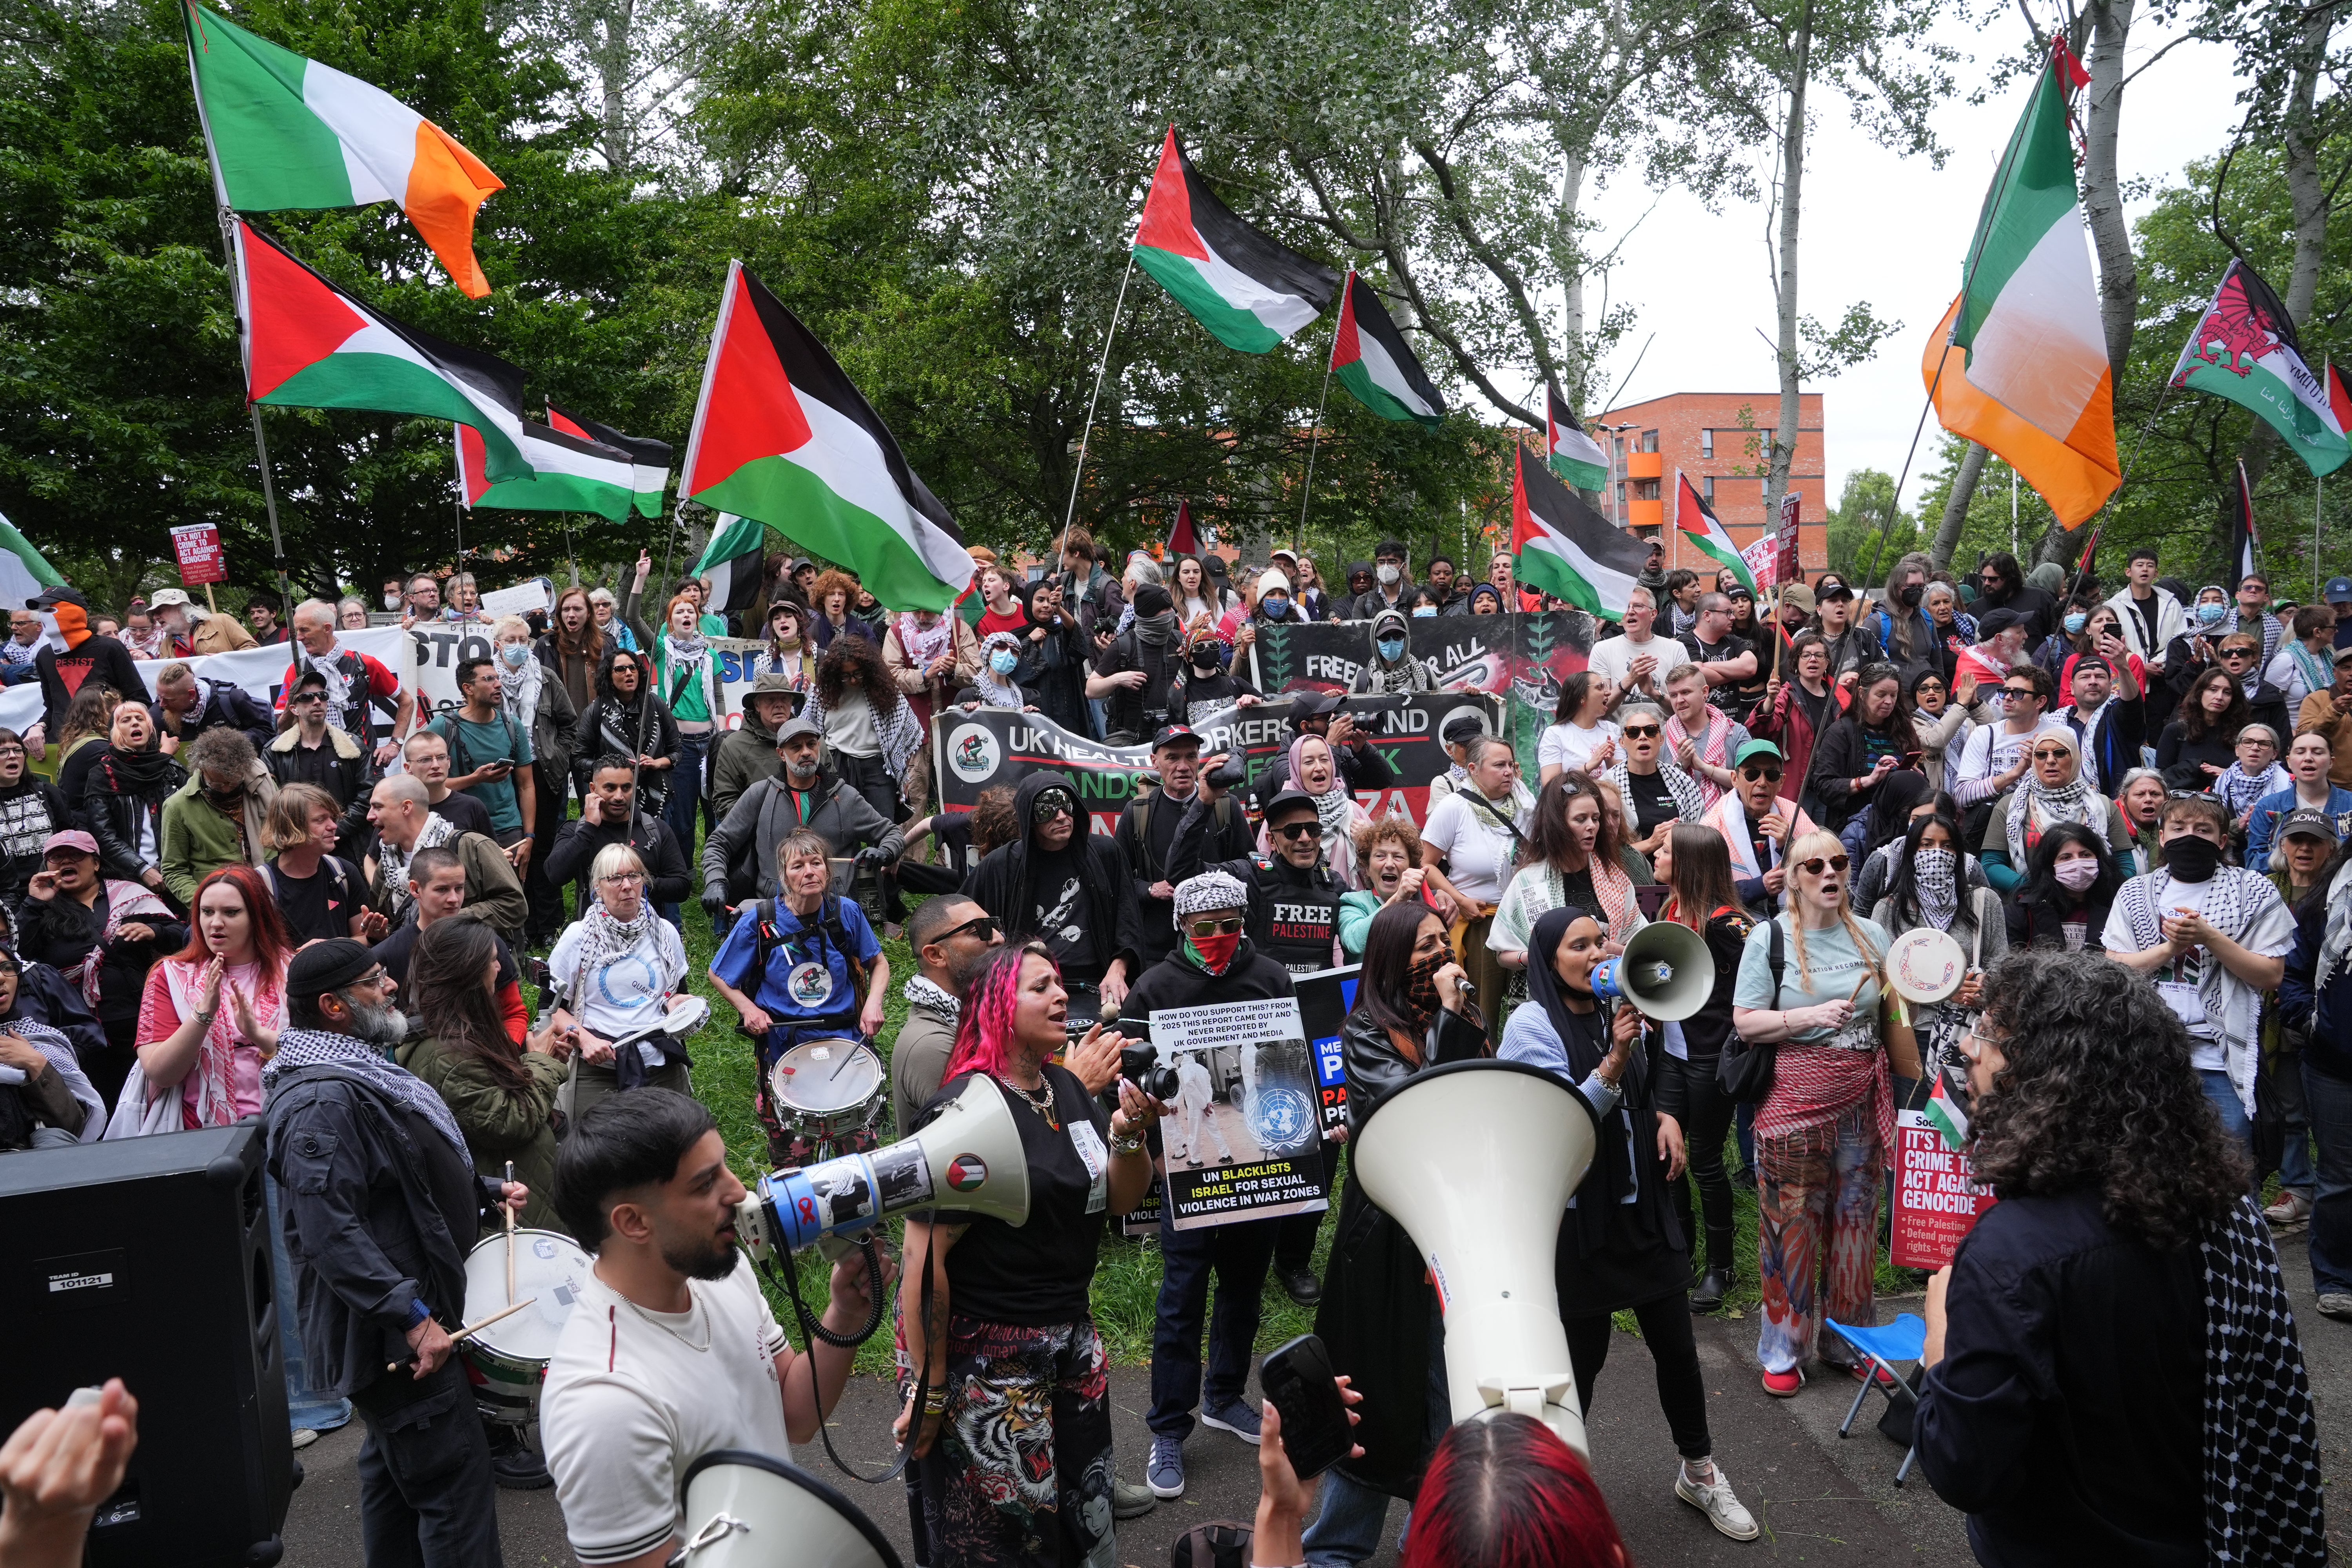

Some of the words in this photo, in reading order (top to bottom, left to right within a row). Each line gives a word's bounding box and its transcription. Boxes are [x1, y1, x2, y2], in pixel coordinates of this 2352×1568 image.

[189, 532, 201, 540] NOT
[177, 540, 198, 550] CRIME
[180, 548, 191, 557] ACT
[193, 544, 218, 555] AGAINST
[1754, 545, 1763, 555] NOT
[181, 553, 212, 564] GENOCIDE
[1756, 551, 1777, 567] AGAINST
[1760, 550, 1768, 558] TO
[408, 631, 495, 668] STO
[1446, 637, 1485, 667] ALL
[55, 658, 95, 667] RESIST
[1009, 726, 1049, 754] UK
[1198, 719, 1289, 753] ORKERS
[2291, 813, 2324, 824] HOWL
[1525, 898, 1545, 909] TERRORISM
[1526, 906, 1539, 916] FREE
[1540, 902, 1549, 911] THE
[1274, 903, 1332, 924] FREE
[1272, 923, 1330, 939] PALESTINE
[1285, 963, 1319, 973] PALESTINE
[1795, 966, 1833, 975] OPRATION
[632, 980, 657, 1000] QUAKER
[1158, 1013, 1177, 1021] HOW
[1210, 1006, 1246, 1015] SUPPORT
[1248, 1004, 1269, 1012] THIS?
[1203, 1016, 1233, 1025] REPORT
[1216, 1023, 1256, 1033] REPORTED
[1187, 1034, 1240, 1045] GOVERNMENT
[1320, 1041, 1342, 1055] ME
[1906, 1130, 1934, 1151] IT'S
[1904, 1149, 1953, 1172] CRIME
[1080, 1148, 1099, 1189] PALESTINE
[1202, 1172, 1220, 1183] UN
[1222, 1162, 1291, 1180] BLACKLISTS
[1191, 1185, 1234, 1198] ISRAEL
[1235, 1180, 1259, 1192] FOR
[1261, 1174, 1306, 1189] SEXUAL
[1903, 1170, 1933, 1191] ACT
[1179, 1196, 1238, 1214] VIOLENCE
[1239, 1194, 1252, 1206] IN
[1254, 1190, 1281, 1203] WAR
[1283, 1185, 1321, 1200] ZONES
[1902, 1189, 1976, 1215] GENOCIDE
[1907, 1215, 1926, 1227] Free
[1929, 1217, 1965, 1232] Palestine
[1907, 1227, 1936, 1241] Defend
[1907, 1241, 1931, 1253] rights
[1906, 1256, 1951, 1266] socialistworker.co.uk
[60, 1276, 102, 1288] 101121
[1431, 1253, 1451, 1306] RESISTANCE
[947, 1337, 977, 1354] good
[982, 1343, 1018, 1359] omen
